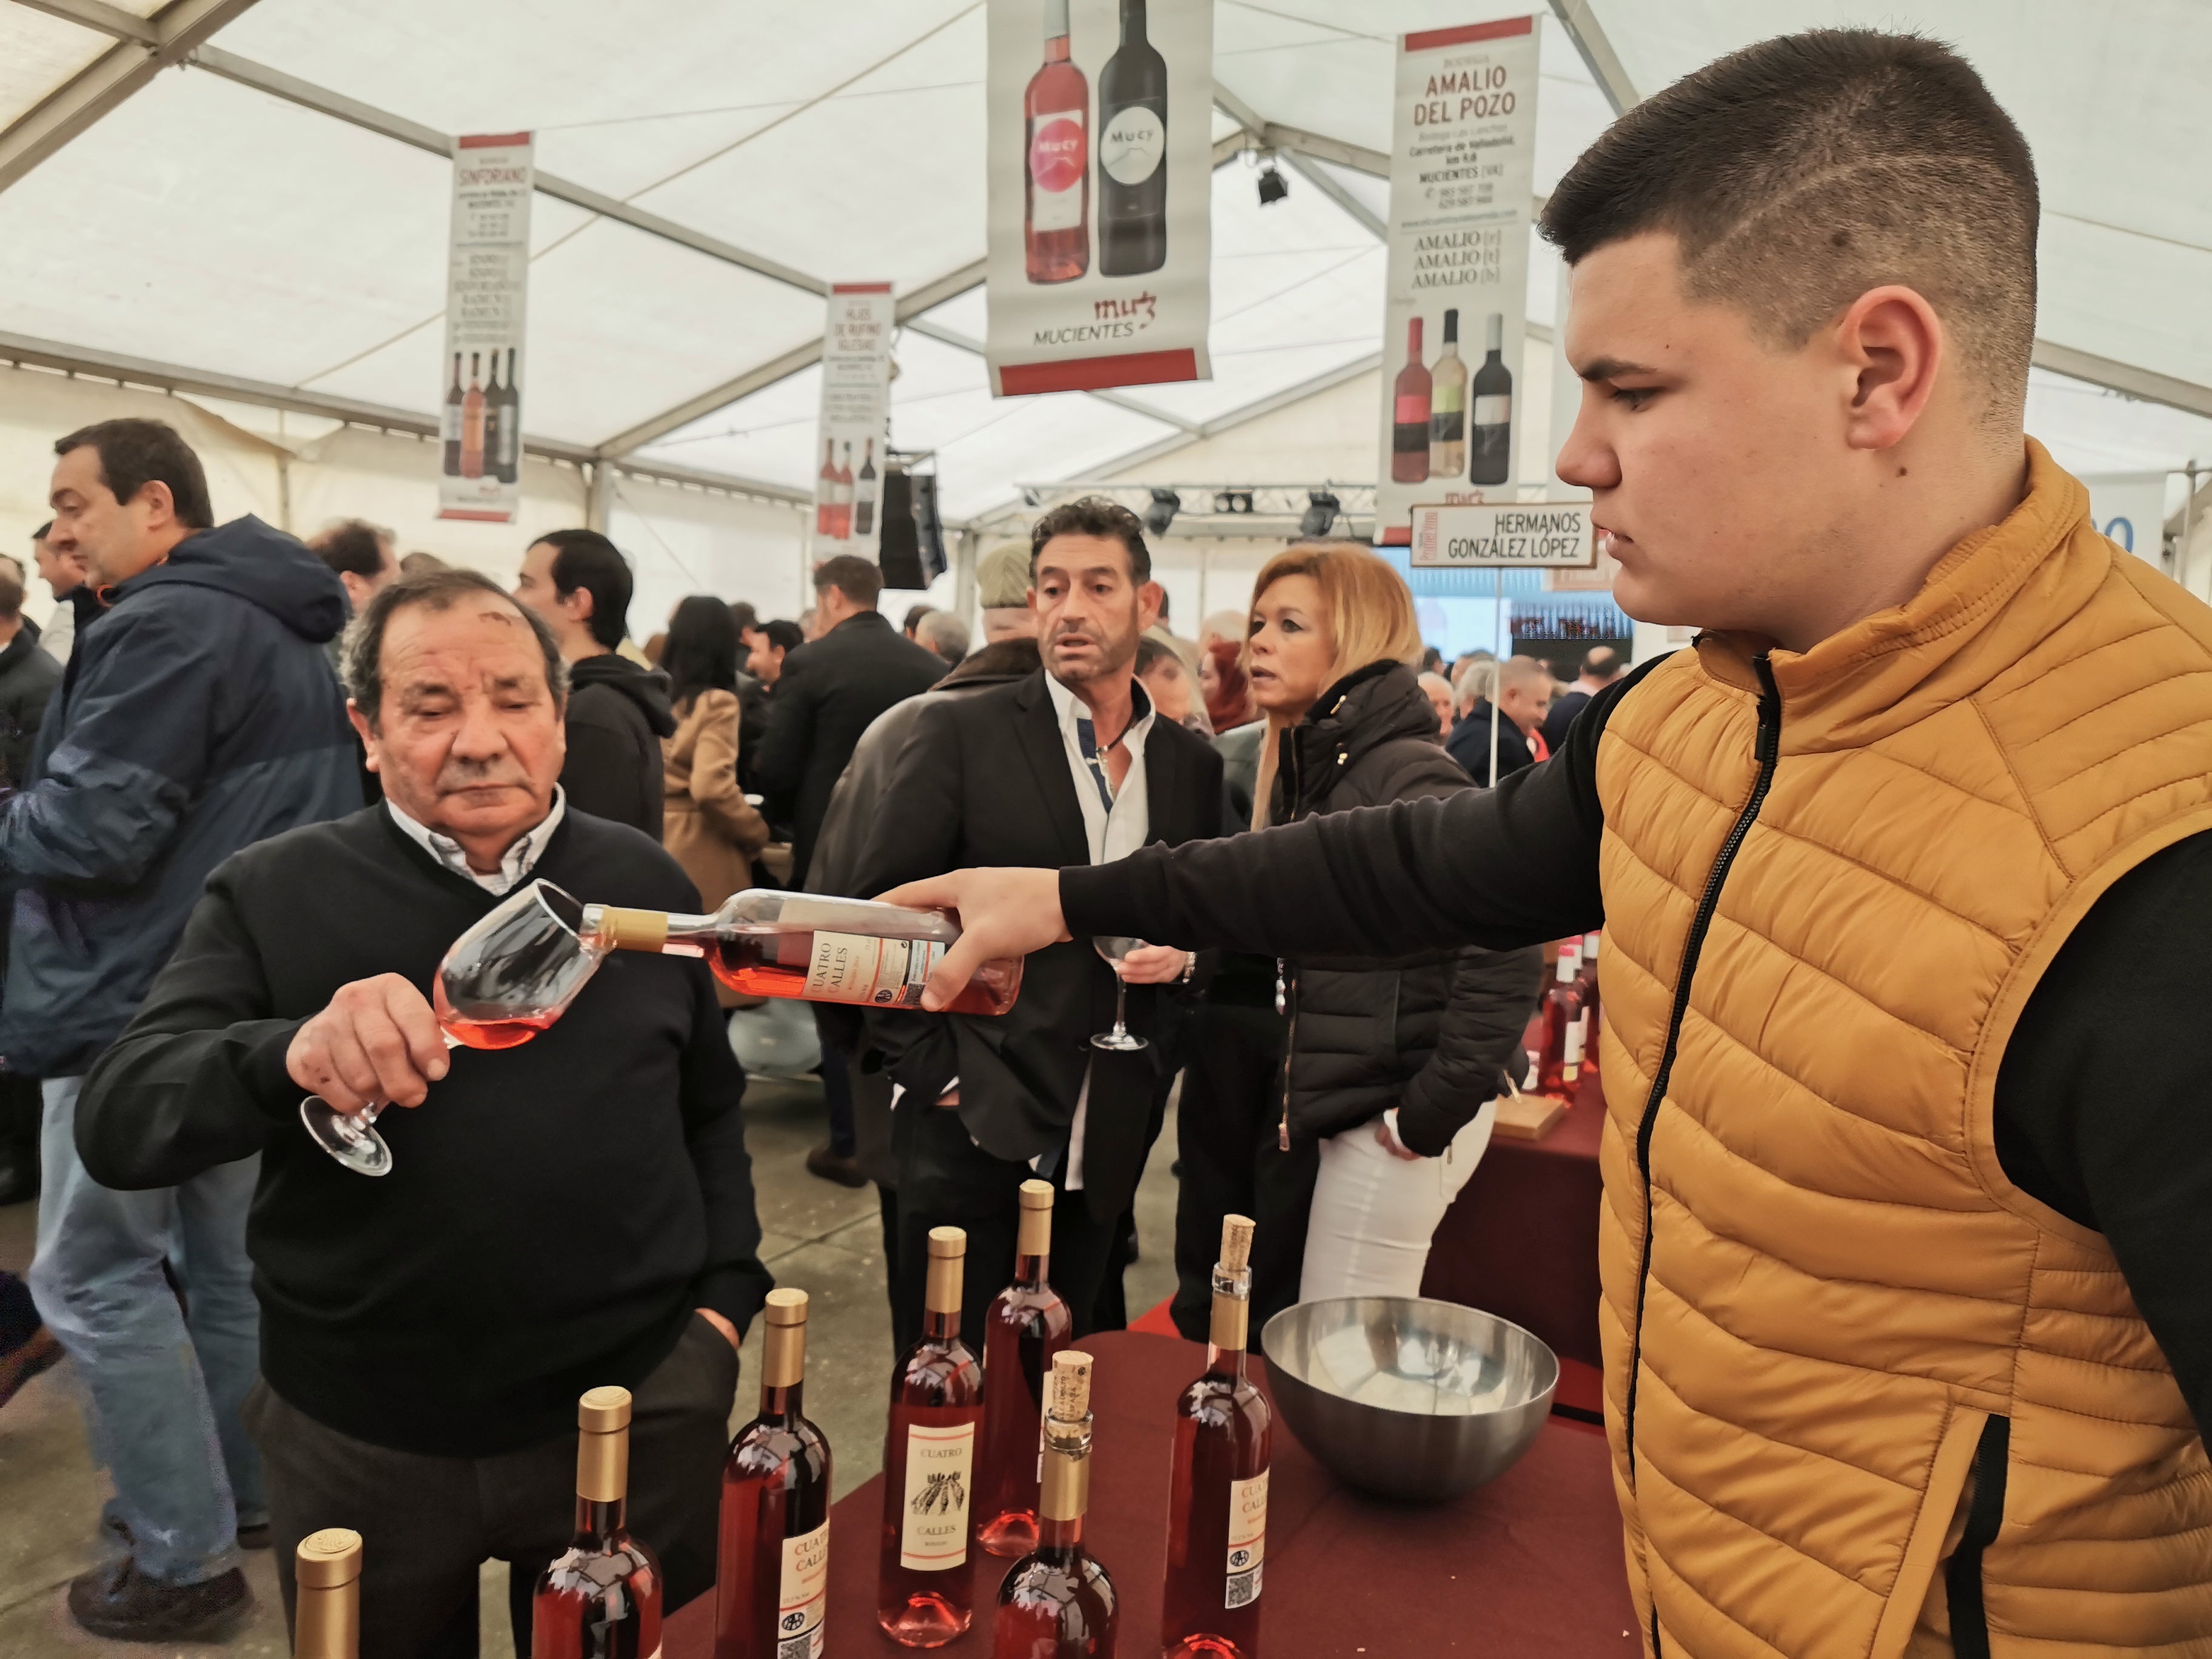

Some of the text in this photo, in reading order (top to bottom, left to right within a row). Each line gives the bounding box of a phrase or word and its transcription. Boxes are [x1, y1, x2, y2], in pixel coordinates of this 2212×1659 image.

[1426, 65, 1507, 98] AMALIO
[1414, 91, 1515, 126] DEL POZO
[1419, 166, 1478, 184] MUCIENTES
[1413, 230, 1481, 252] AMALIO
[1413, 249, 1481, 270] AMALIO
[1411, 268, 1478, 290] AMALIO
[1033, 321, 1134, 347] MUCIENTES
[1495, 512, 1581, 534] HERMANOS
[1448, 532, 1527, 559] GONZÁLEZ
[1530, 531, 1581, 559] LÓPEZ
[811, 942, 833, 993] CUATRO
[827, 946, 848, 993] CALLES
[920, 1447, 963, 1458] CUATRO
[916, 1524, 957, 1536] CALLES
